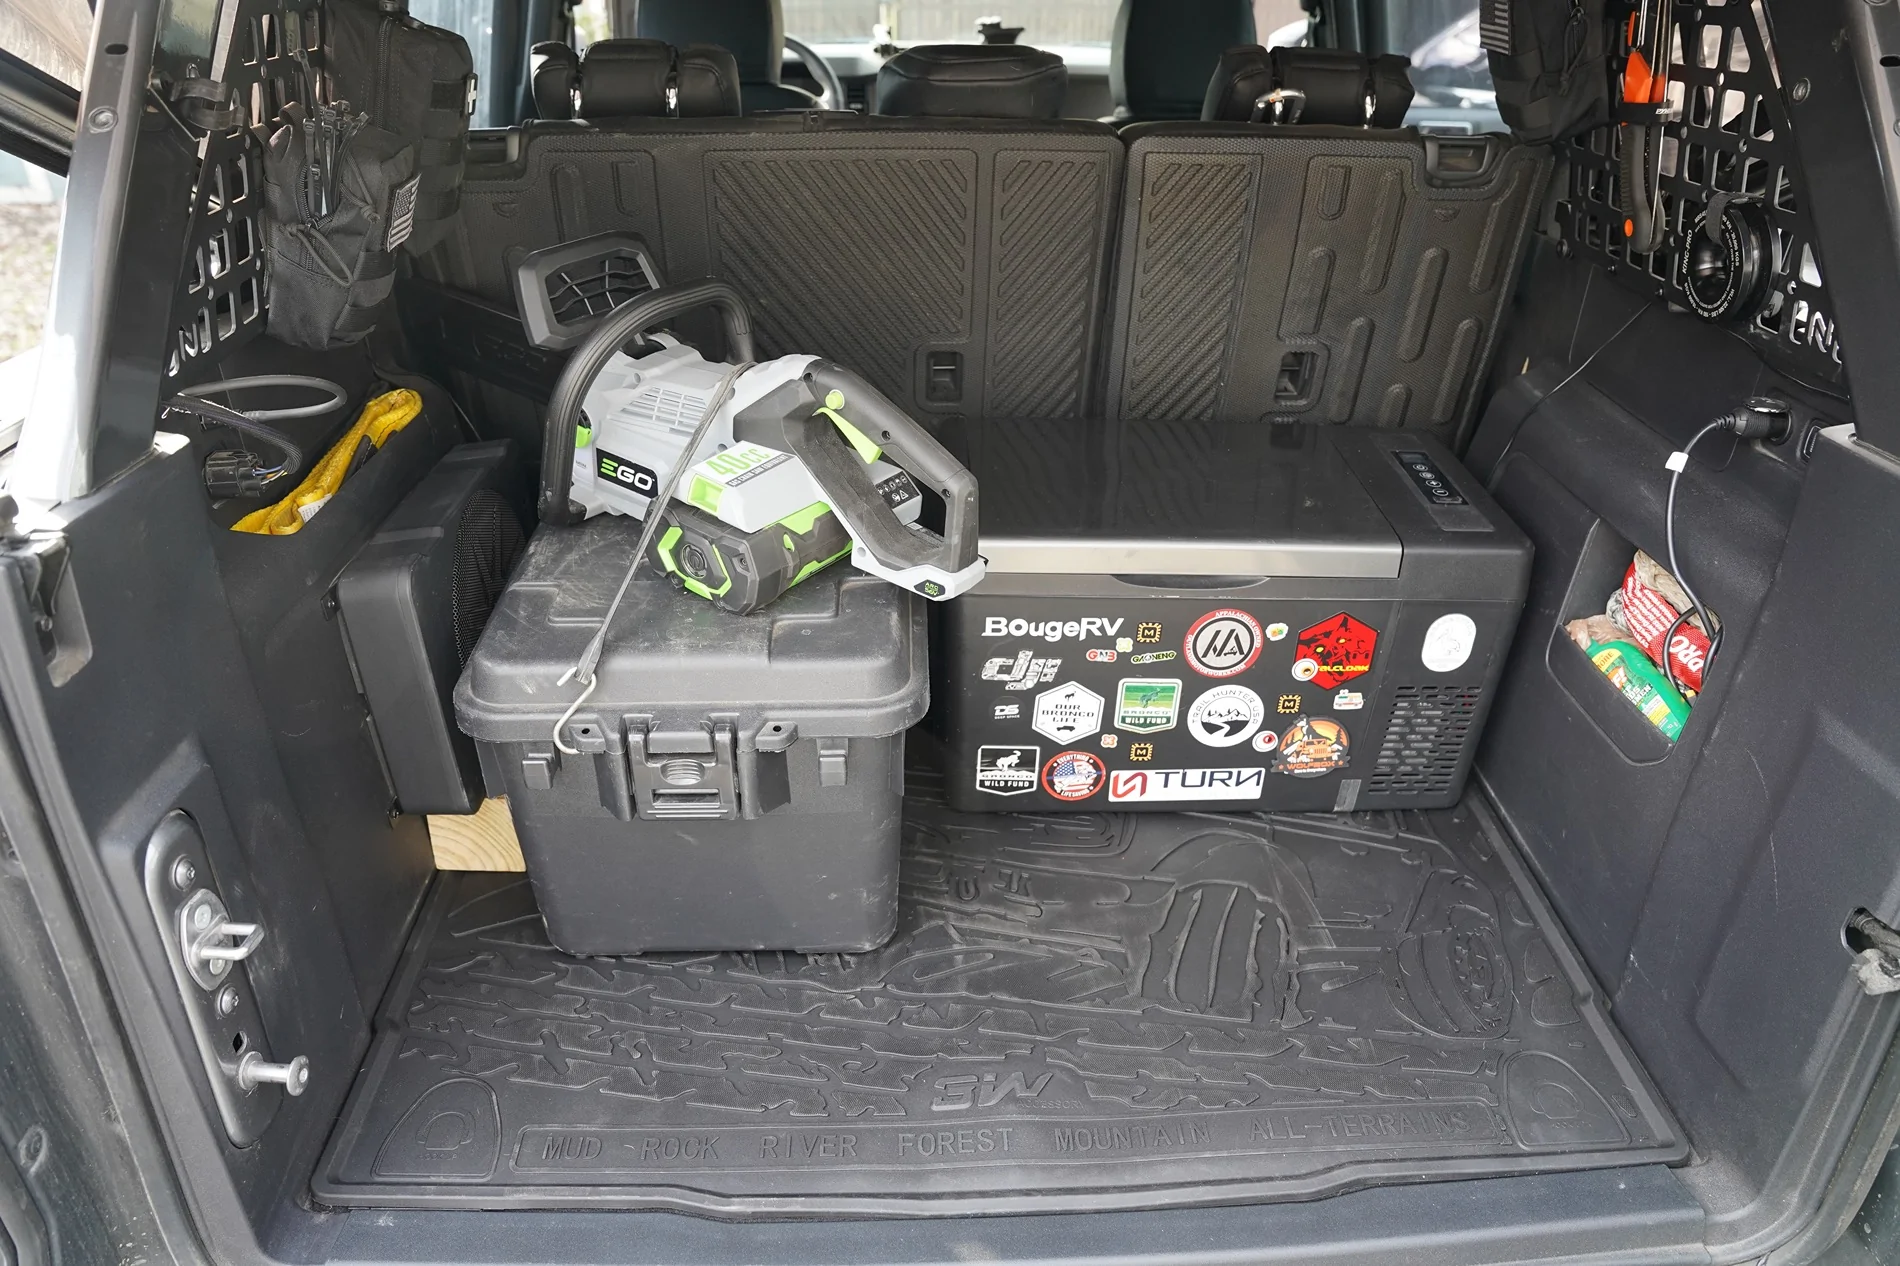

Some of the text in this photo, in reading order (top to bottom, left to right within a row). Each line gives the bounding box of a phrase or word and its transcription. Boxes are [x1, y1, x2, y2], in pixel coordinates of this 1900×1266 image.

[1682, 229, 1692, 274] KING-PRO
[601, 458, 653, 490] EGO
[981, 617, 1124, 642] BougeRV
[1215, 611, 1256, 628] APPALACHIAN
[1670, 635, 1704, 673] PRO
[1192, 700, 1210, 723] TRAIL
[1212, 690, 1255, 703] HUNTER
[1286, 761, 1336, 770] WOLFBOX
[542, 1111, 1472, 1161] MUD ROCK RIVER FOREST MOUNTAIN ALL-TERRAINS
